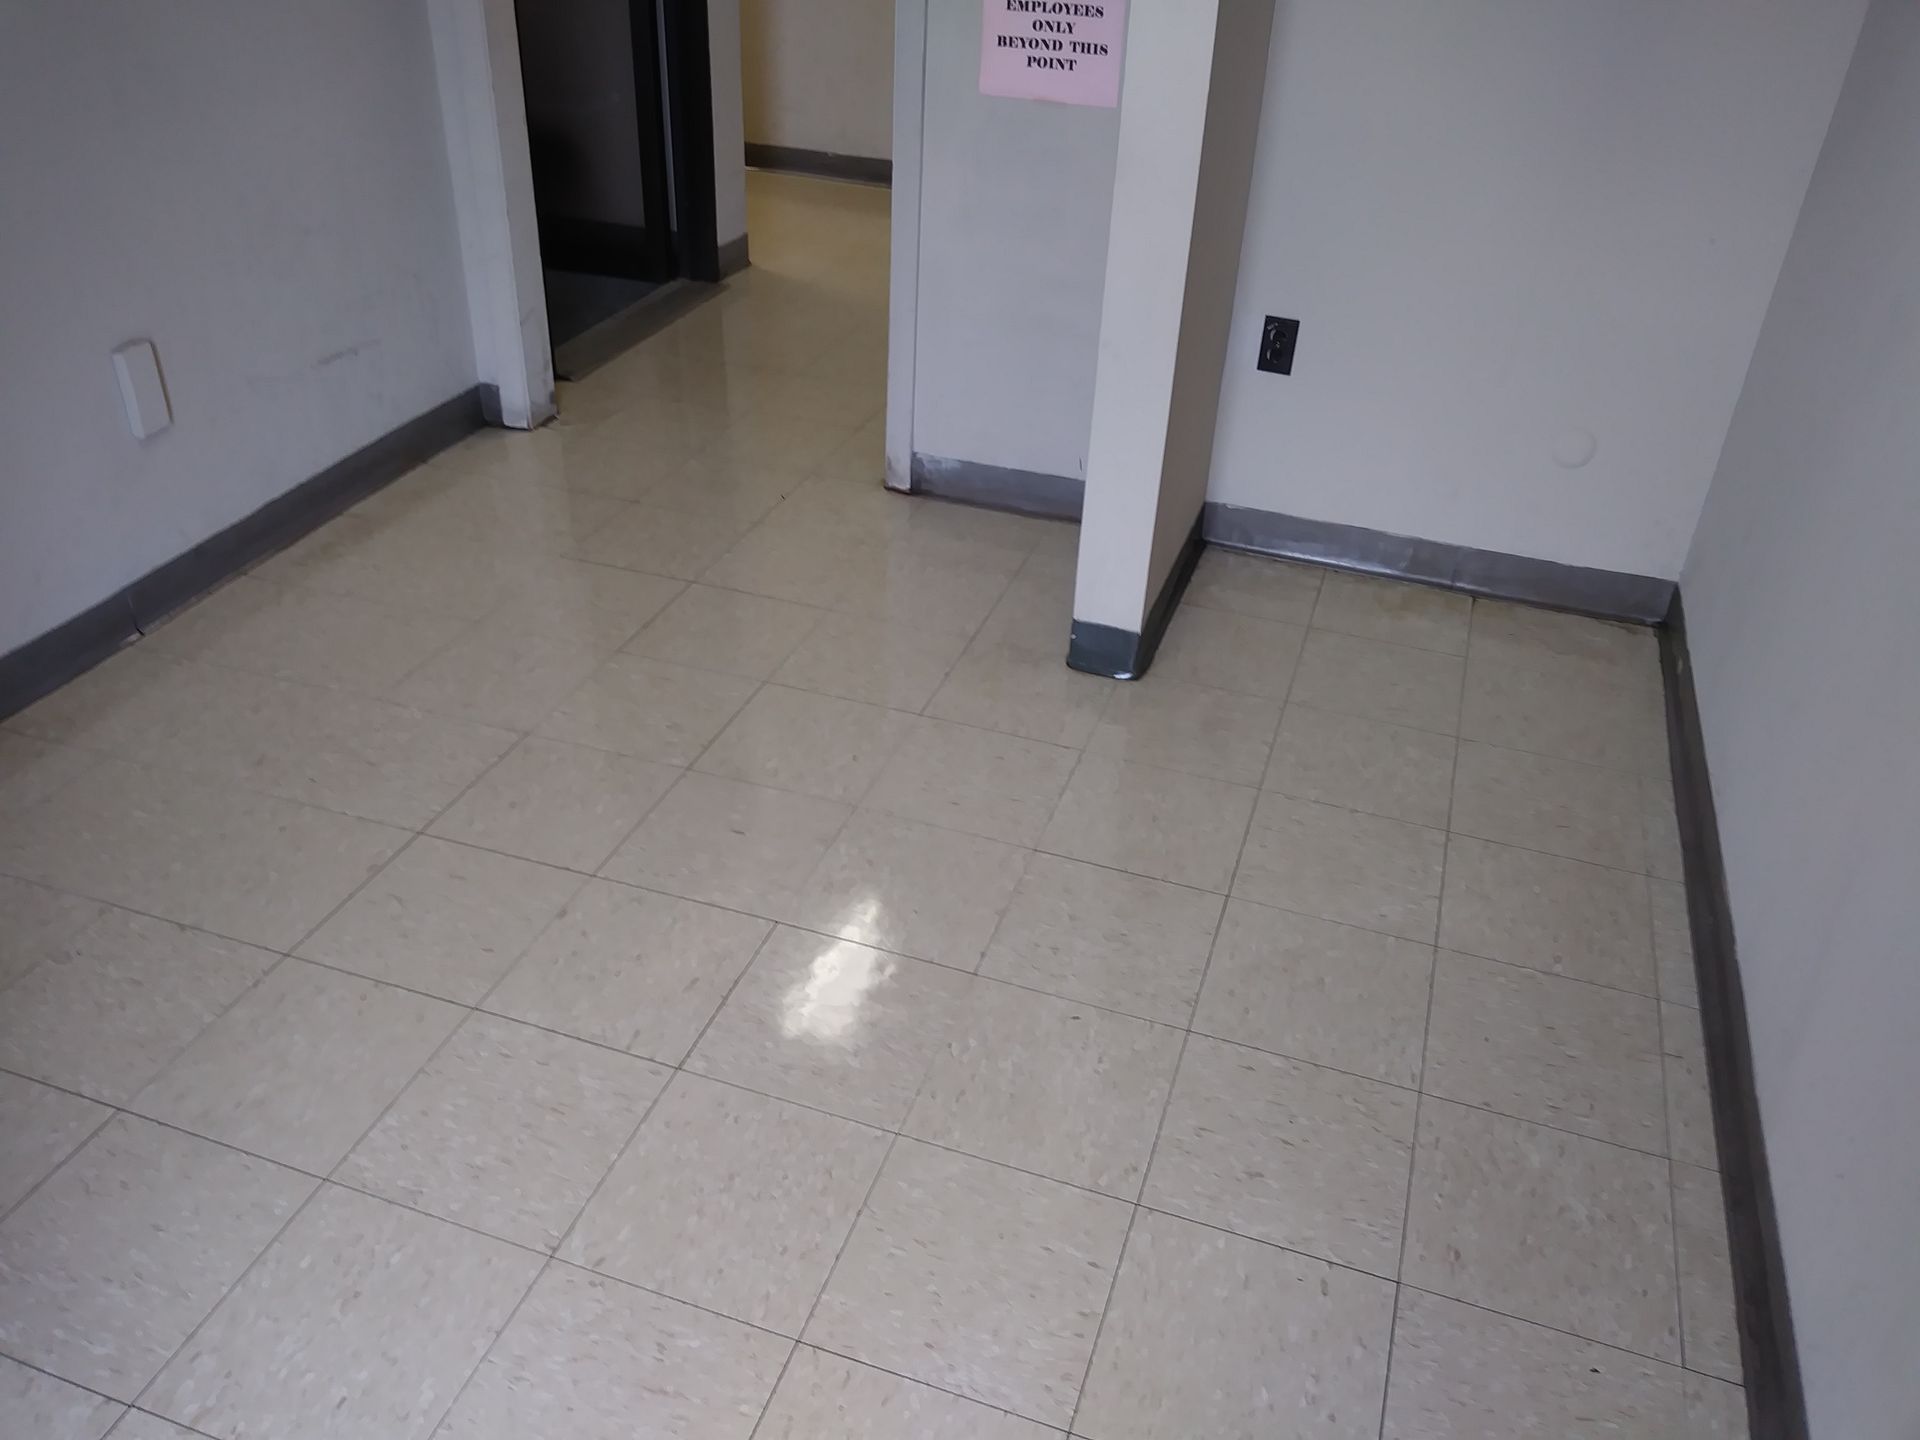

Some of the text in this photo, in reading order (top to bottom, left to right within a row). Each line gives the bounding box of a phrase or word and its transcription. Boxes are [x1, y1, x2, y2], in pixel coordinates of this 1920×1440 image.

[1006, 0, 1103, 18] EMPLOYEES
[1032, 19, 1075, 34] ONLY
[997, 35, 1108, 56] BEYOND THIS
[1027, 56, 1077, 71] POINT
